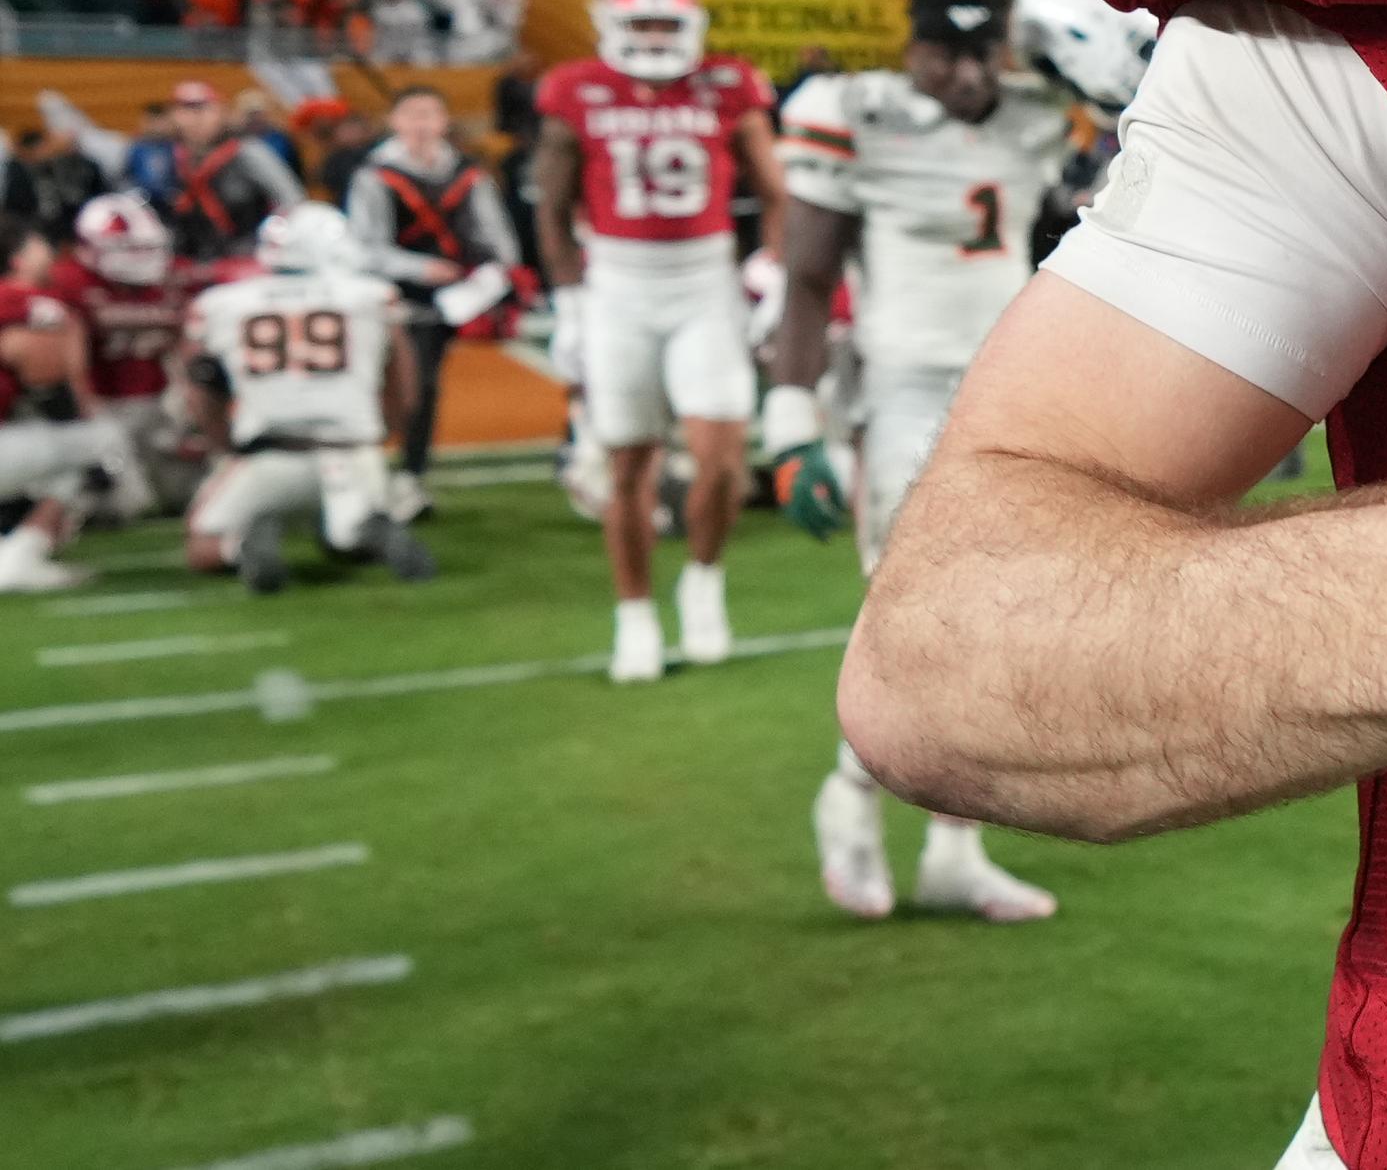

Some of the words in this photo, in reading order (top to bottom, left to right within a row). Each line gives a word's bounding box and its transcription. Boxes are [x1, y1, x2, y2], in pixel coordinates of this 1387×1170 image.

[609, 138, 712, 219] 19
[959, 182, 1008, 258] 1
[243, 312, 346, 375] 99
